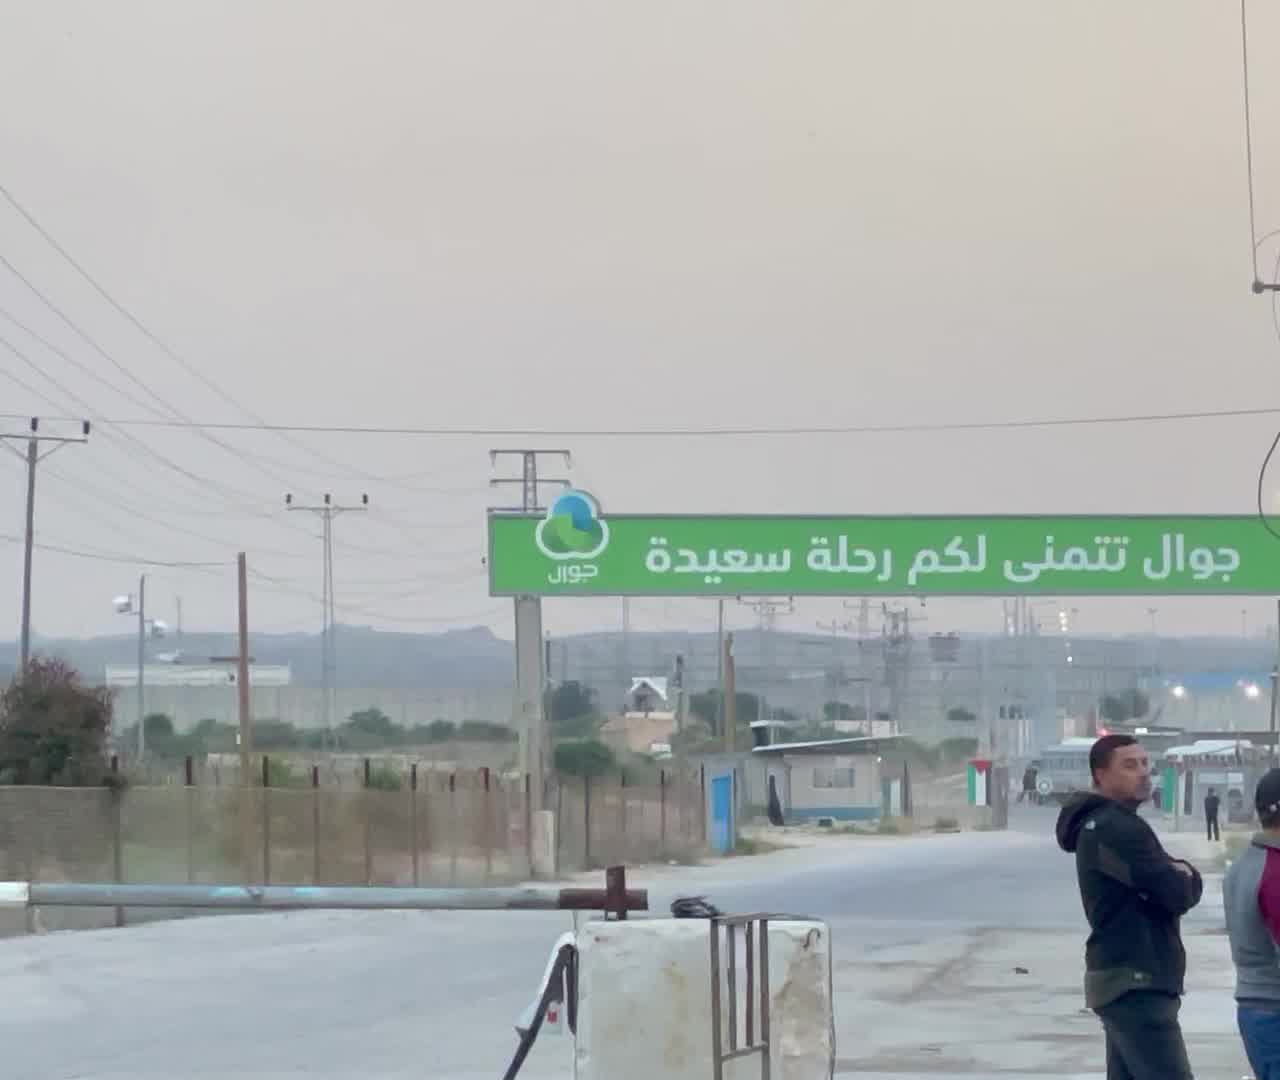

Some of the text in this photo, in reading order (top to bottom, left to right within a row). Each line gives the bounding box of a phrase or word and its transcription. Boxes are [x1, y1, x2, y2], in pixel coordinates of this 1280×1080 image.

[547, 562, 599, 584] جوال
[645, 532, 1241, 586] جوال تتمنى لكم رحلة سعيدة
